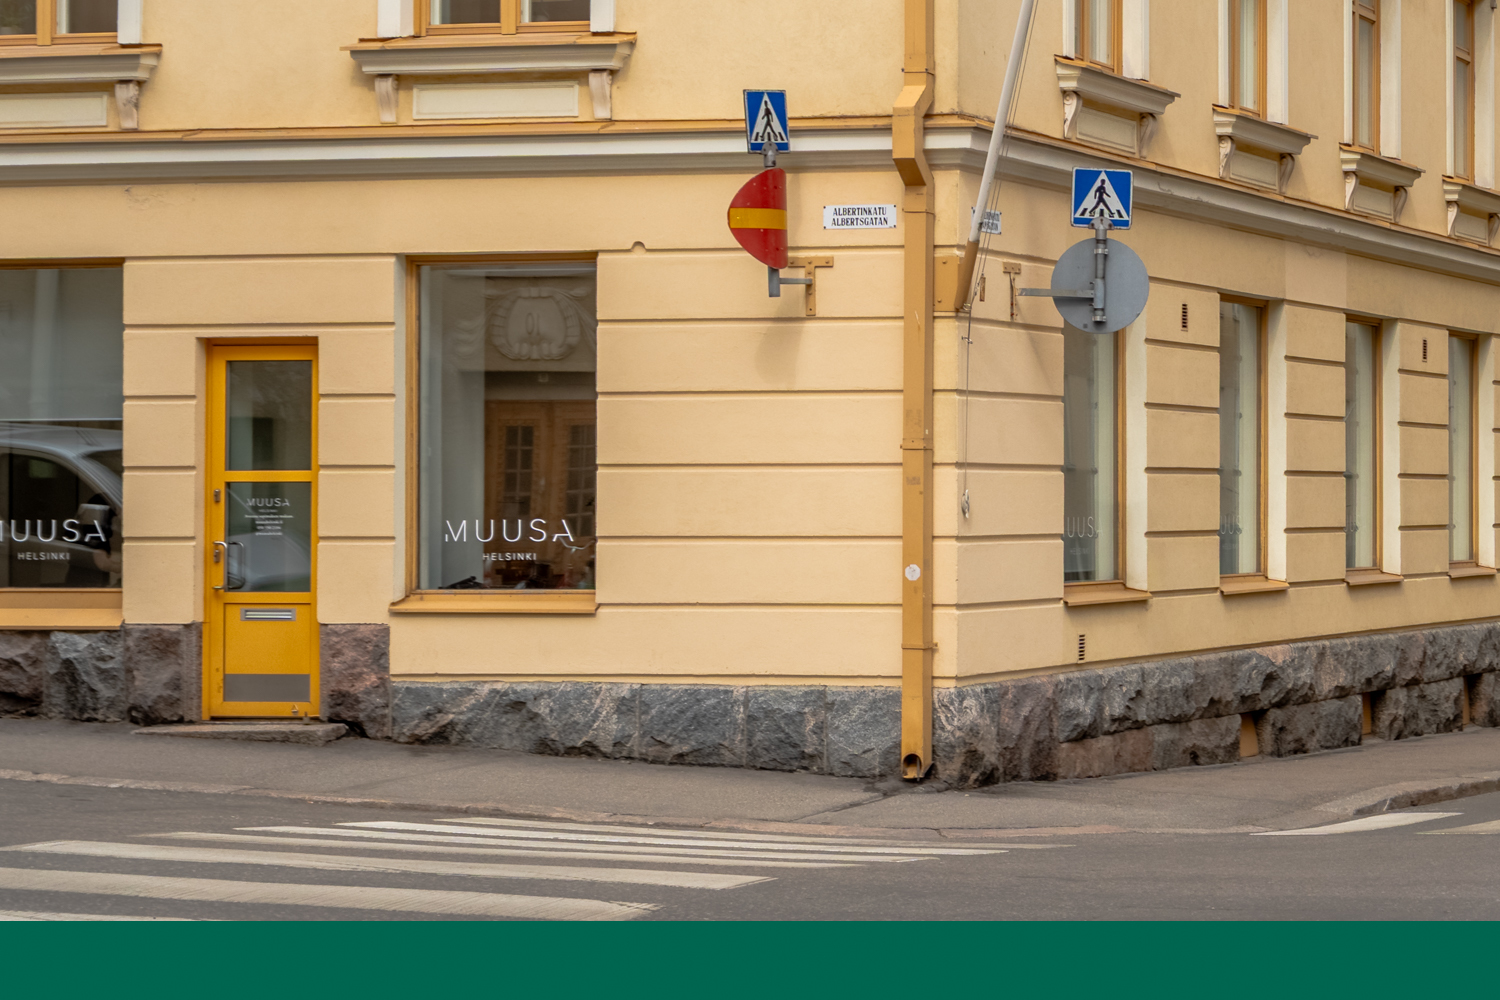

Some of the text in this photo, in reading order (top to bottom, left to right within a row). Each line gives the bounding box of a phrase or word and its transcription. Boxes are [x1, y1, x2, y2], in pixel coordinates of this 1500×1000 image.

[833, 206, 887, 216] ALBERTINKATU
[831, 217, 888, 226] ALBERTSGATAN
[245, 497, 290, 507] MUUSA
[444, 518, 575, 543] MUUSA
[17, 551, 71, 560] HELSINKI
[482, 552, 537, 561] HELSINKI
